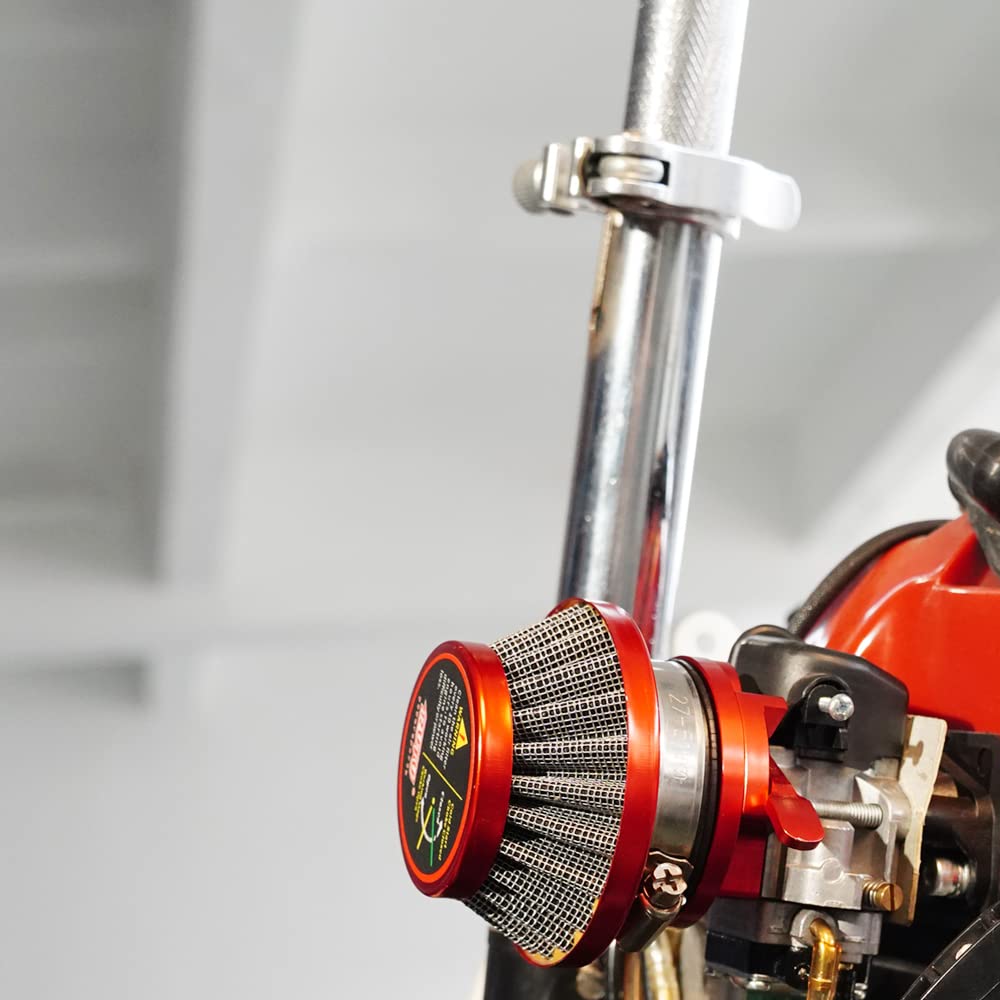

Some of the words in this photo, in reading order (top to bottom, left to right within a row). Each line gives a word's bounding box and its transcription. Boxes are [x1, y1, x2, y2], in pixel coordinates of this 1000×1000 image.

[441, 678, 451, 711] engine
[450, 685, 458, 711] every
[453, 689, 462, 716] Clean
[432, 712, 443, 752] starting
[436, 728, 444, 759] avoid
[440, 724, 449, 761] working
[450, 705, 463, 756] WARNING
